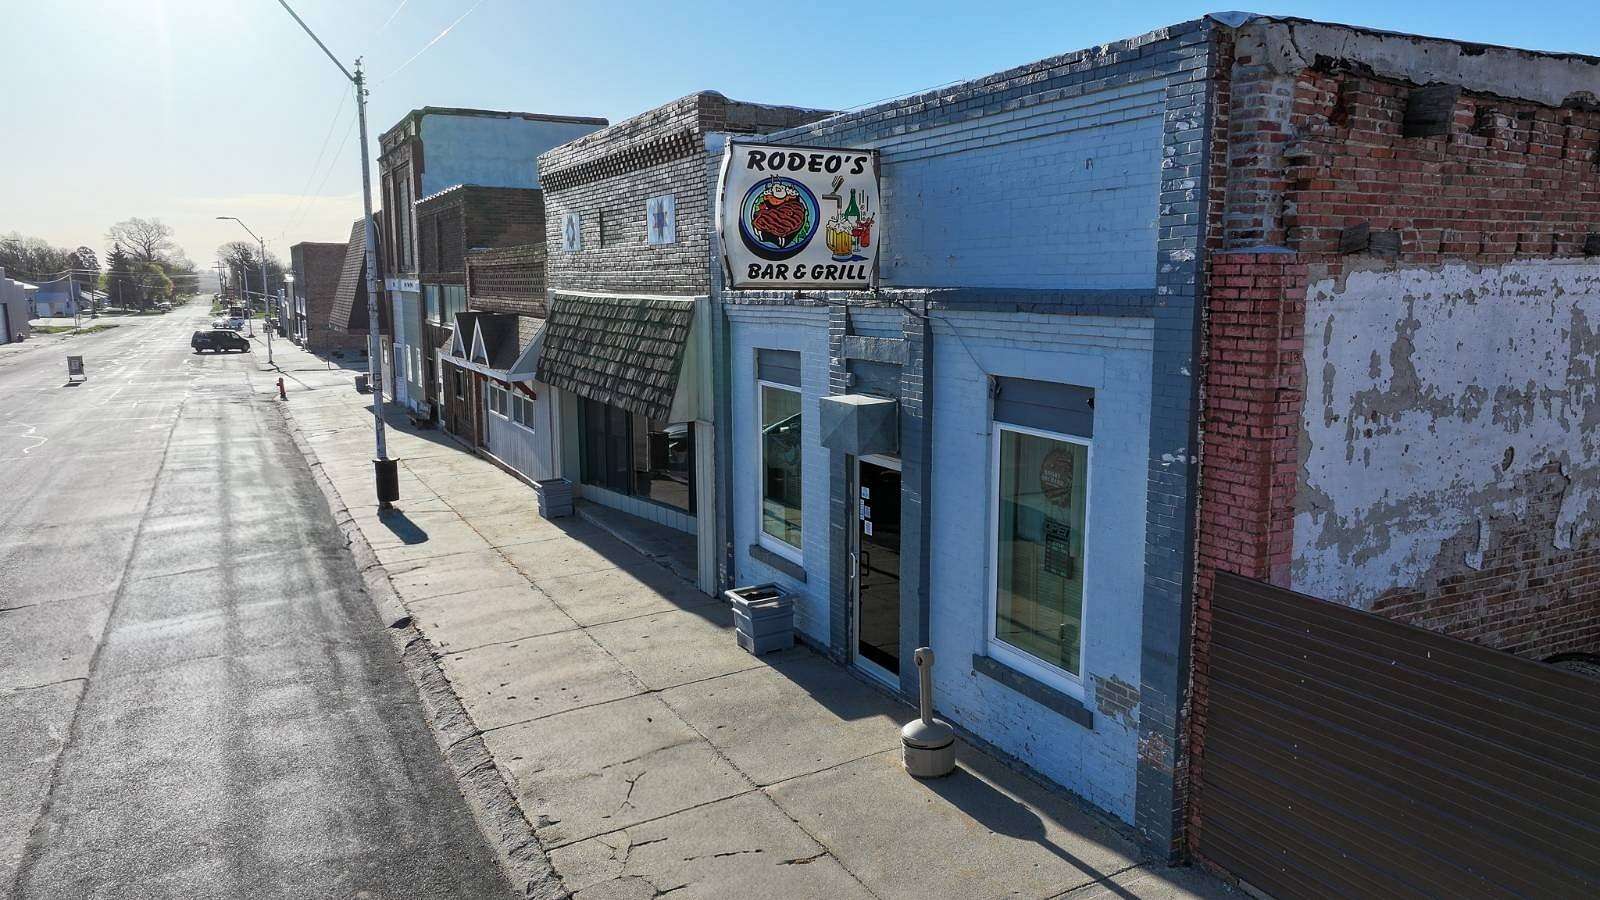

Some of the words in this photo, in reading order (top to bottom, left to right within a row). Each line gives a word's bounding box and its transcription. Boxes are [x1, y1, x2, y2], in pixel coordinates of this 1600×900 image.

[747, 150, 867, 174] RODEO'S
[748, 263, 788, 280] BAR
[793, 264, 806, 279] &
[811, 264, 866, 281] GRILL
